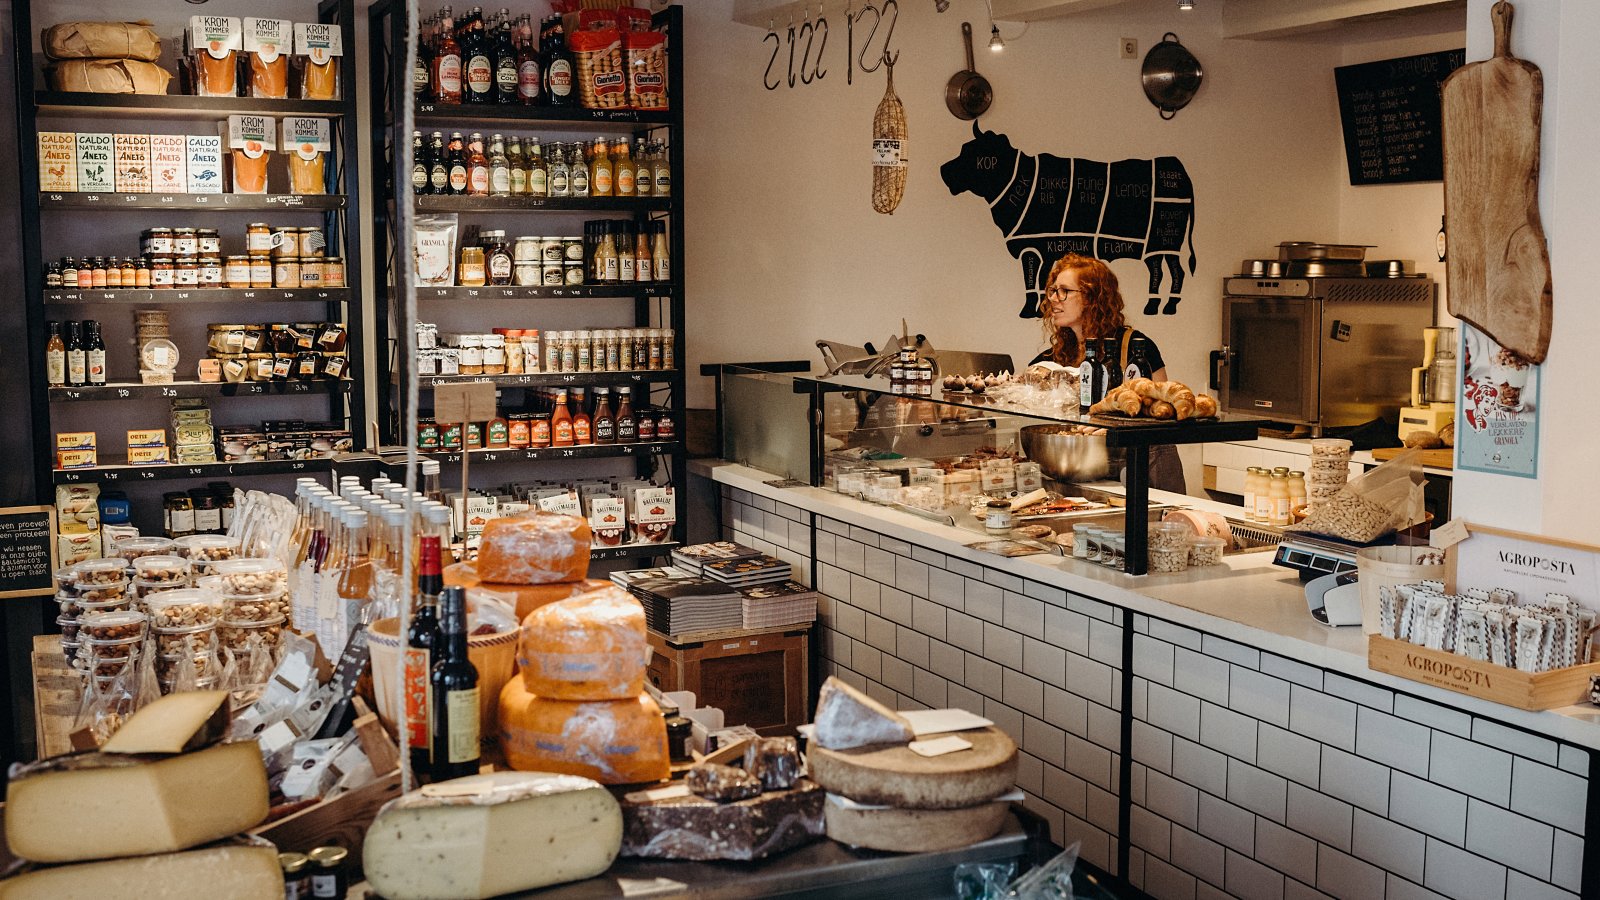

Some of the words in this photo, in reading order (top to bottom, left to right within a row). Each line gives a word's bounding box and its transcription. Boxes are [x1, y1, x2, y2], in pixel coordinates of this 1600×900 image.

[205, 17, 228, 27] KROM
[256, 20, 280, 30] KROM
[306, 25, 330, 35] KROM
[241, 117, 264, 127] KROM
[295, 119, 318, 129] KROM
[79, 136, 110, 144] CALDO
[189, 139, 218, 147] CALDO
[45, 151, 71, 159] ANETO
[82, 152, 108, 160] ANETO
[120, 152, 145, 161] ANETO
[156, 153, 180, 161] ANETO
[192, 154, 216, 162] ANETO
[976, 157, 997, 169] KOP
[1041, 192, 1055, 204] RIB
[1080, 192, 1096, 205] RIB
[1496, 411, 1506, 421] PAS
[1489, 428, 1524, 436] LEKKERE
[1494, 437, 1518, 445] GRANOLA
[1496, 550, 1575, 575] AGROPOSTA
[9, 571, 25, 580] open
[1403, 654, 1490, 688] AGROPOSTA
